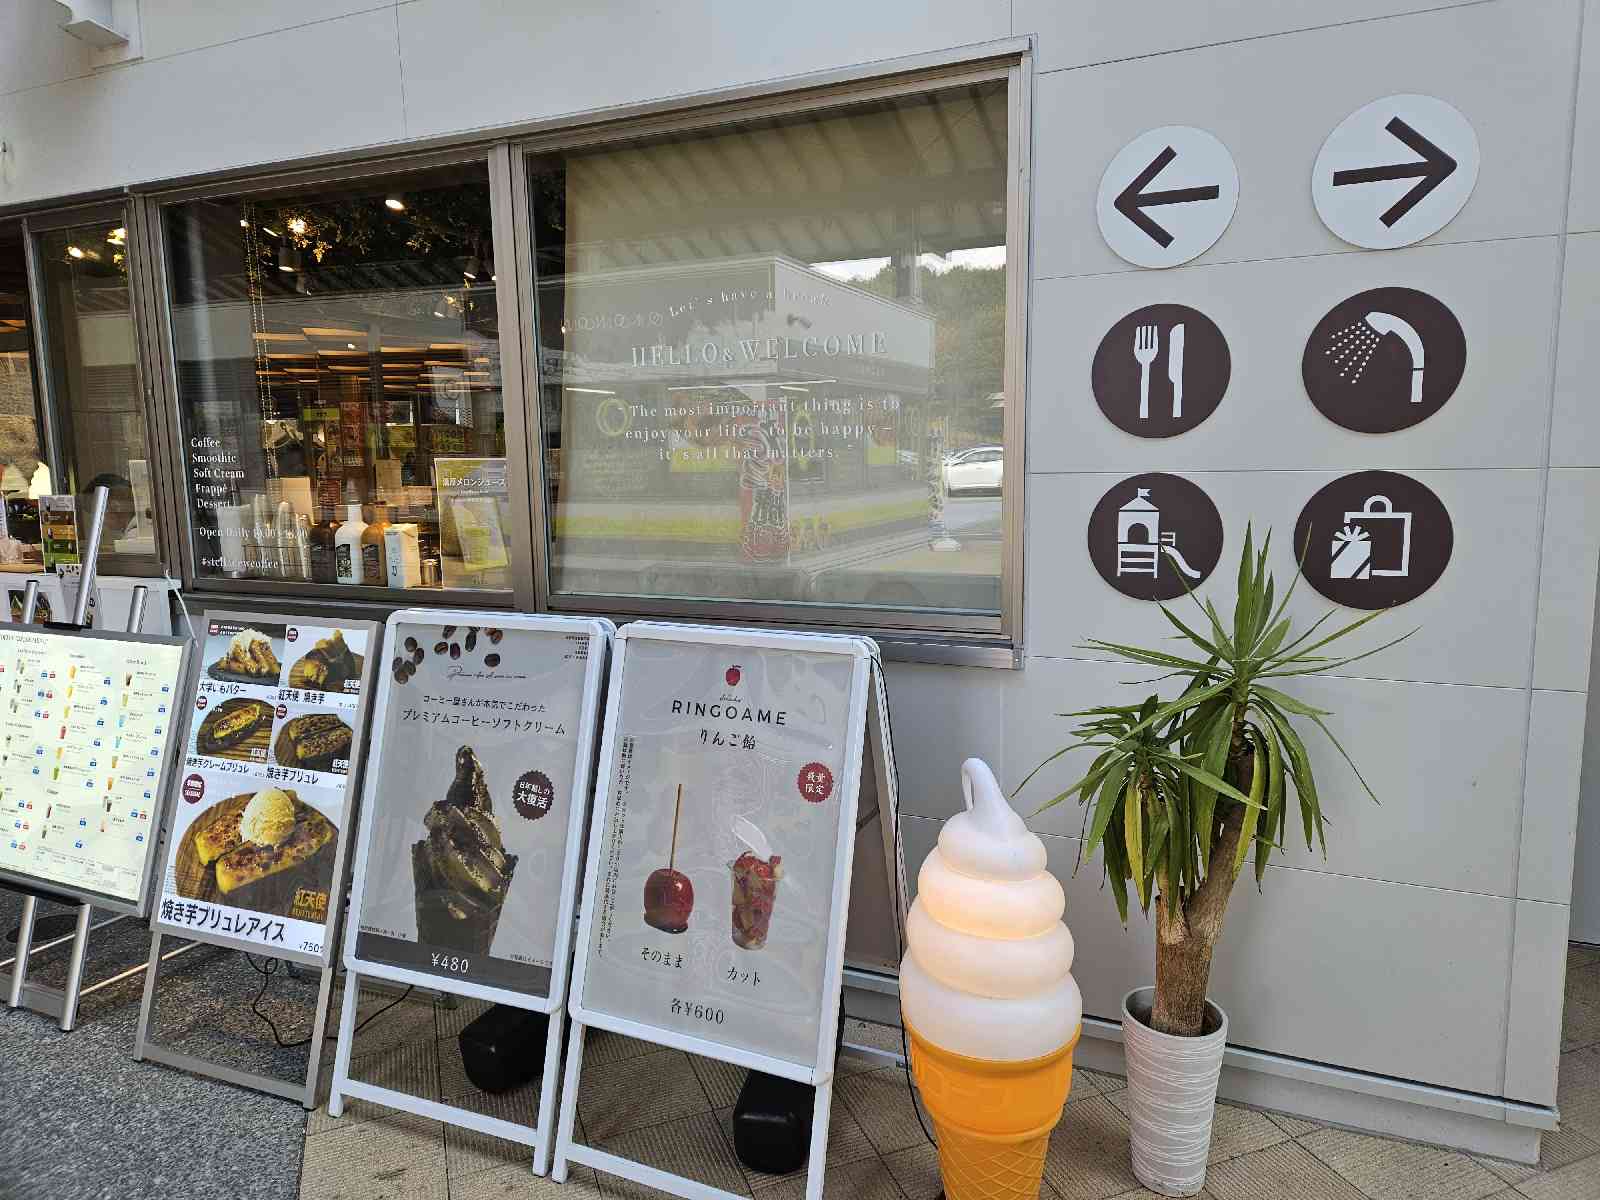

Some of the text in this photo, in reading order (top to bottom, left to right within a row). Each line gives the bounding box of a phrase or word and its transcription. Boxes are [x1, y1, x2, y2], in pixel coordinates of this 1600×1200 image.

[191, 437, 221, 449] Coffee
[192, 452, 236, 463] Smoothie
[193, 467, 245, 479] Soft Cream
[199, 526, 224, 540] Open
[403, 708, 566, 735] プレミアムコーヒーソフトクリーム
[671, 699, 788, 726] RINGOAME
[699, 729, 757, 751] りんご飴
[161, 899, 285, 942] 焼き芋ブリュレアイス
[431, 952, 470, 974] ¥480
[640, 947, 684, 969] そのまま
[727, 967, 761, 986] カット
